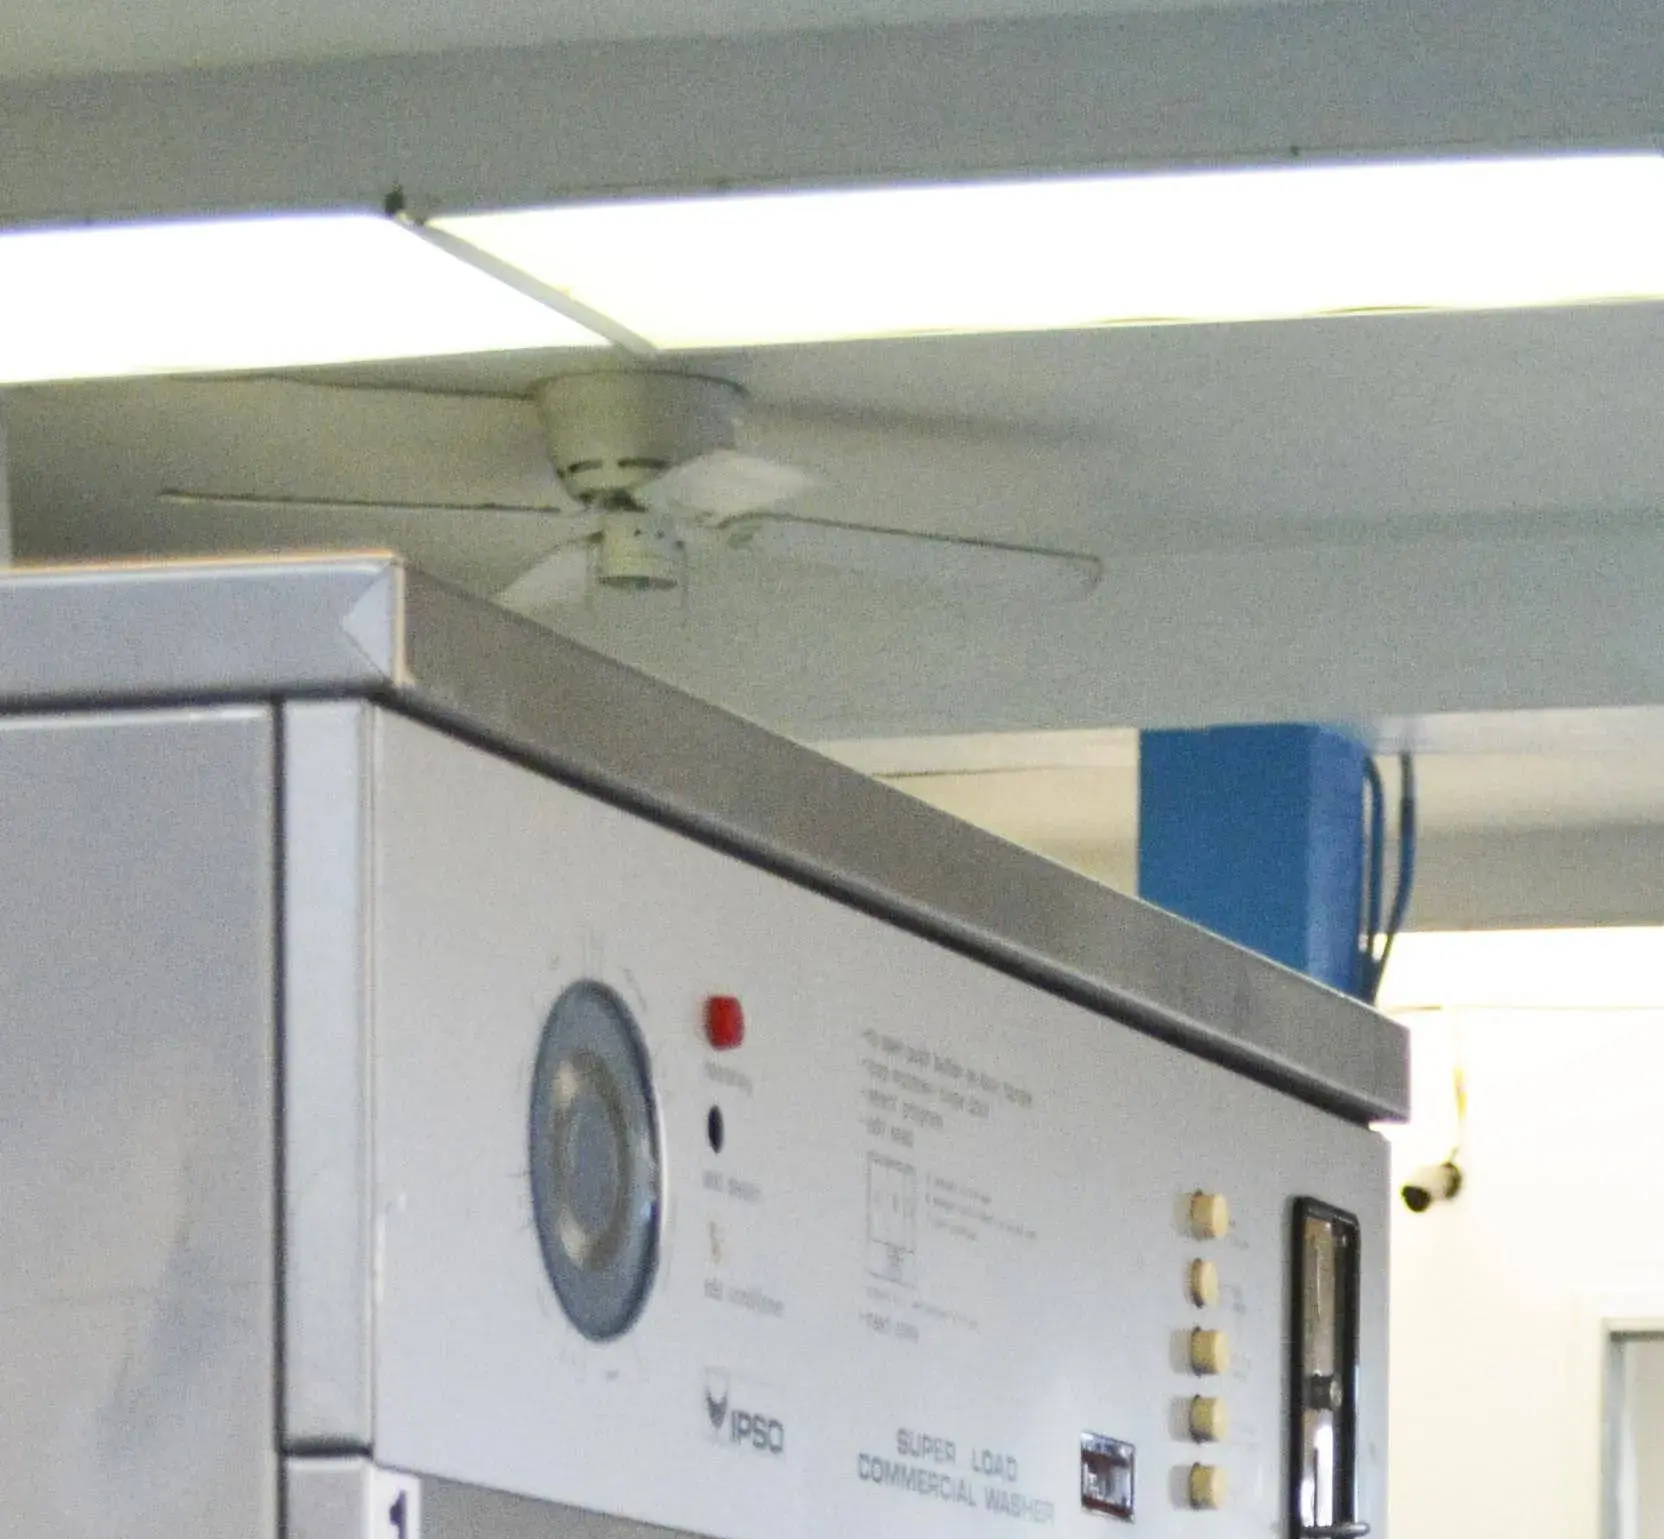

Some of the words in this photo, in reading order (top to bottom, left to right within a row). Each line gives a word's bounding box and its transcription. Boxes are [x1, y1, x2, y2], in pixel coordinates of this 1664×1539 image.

[730, 1409, 785, 1454] IPSO
[897, 1428, 956, 1465] SUPER
[972, 1448, 1018, 1483] LOAD
[857, 1452, 977, 1507] COMMERCIAL
[985, 1486, 1054, 1527] WASHER
